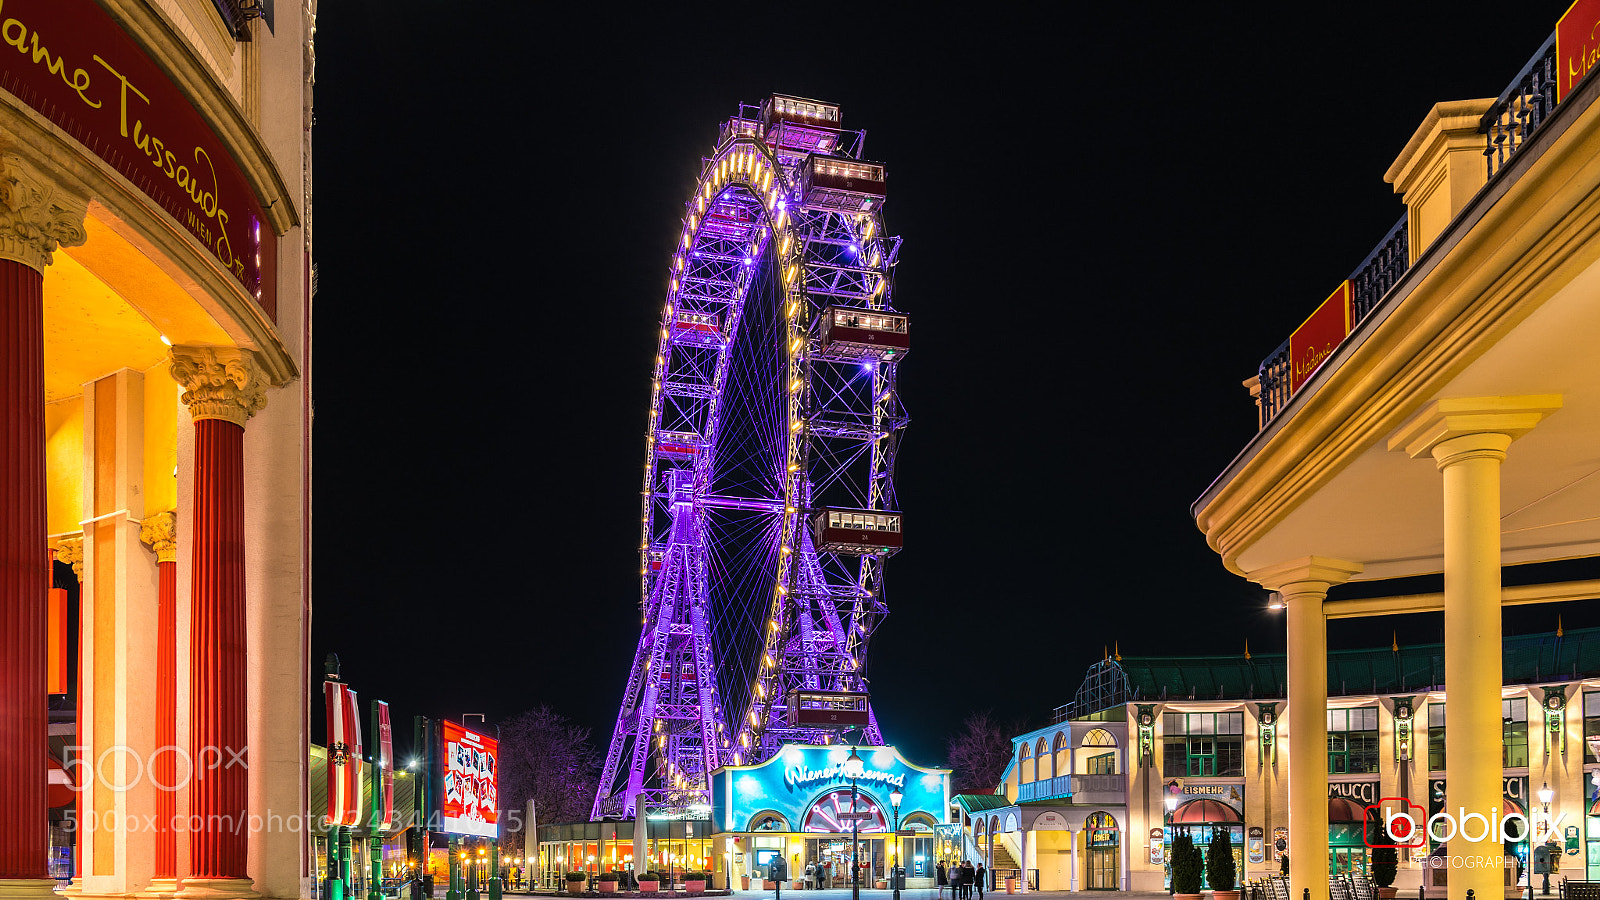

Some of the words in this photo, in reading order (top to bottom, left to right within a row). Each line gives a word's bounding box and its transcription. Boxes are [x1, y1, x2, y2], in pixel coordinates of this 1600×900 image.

[0, 0, 102, 109] ame
[93, 54, 233, 268] Tussauds
[187, 208, 212, 245] WIEN
[1296, 342, 1332, 382] Madame
[784, 764, 839, 785] Wiener
[1184, 785, 1224, 795] EISMEHR
